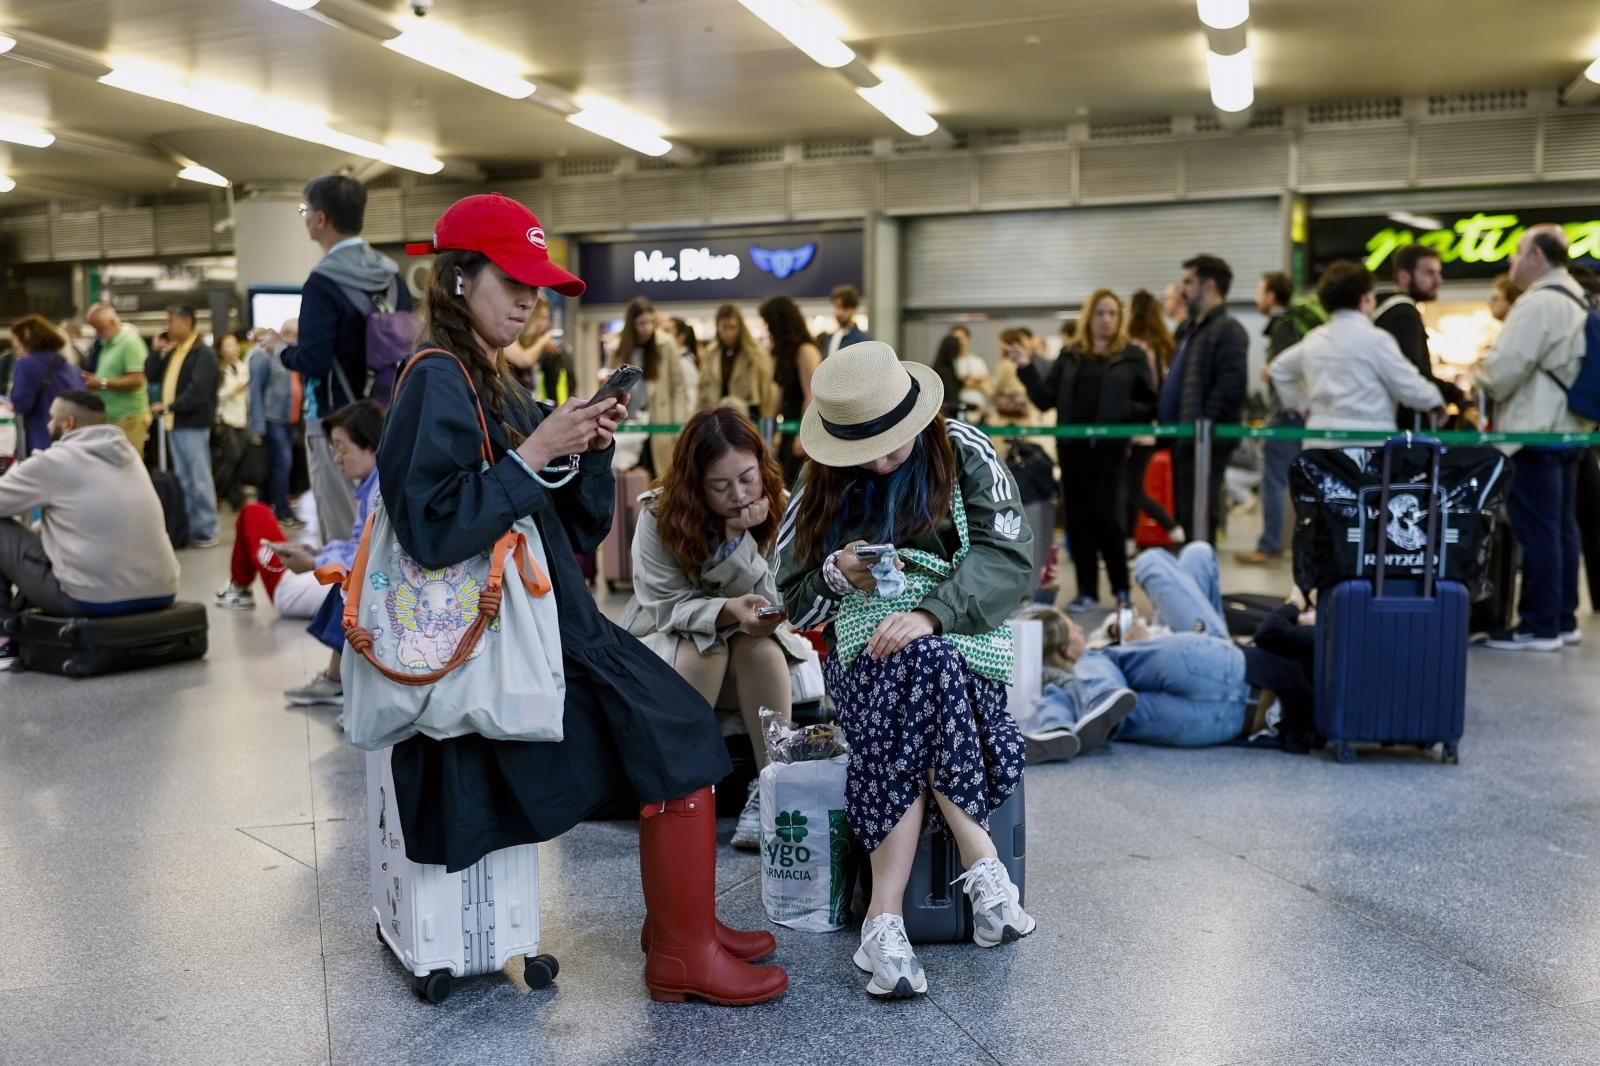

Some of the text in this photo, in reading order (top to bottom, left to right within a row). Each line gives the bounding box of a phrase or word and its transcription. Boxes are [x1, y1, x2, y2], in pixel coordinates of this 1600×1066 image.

[1366, 213, 1600, 272] natua
[680, 247, 740, 281] Blue
[762, 829, 811, 868] ygo
[764, 867, 812, 881] RMACIA
